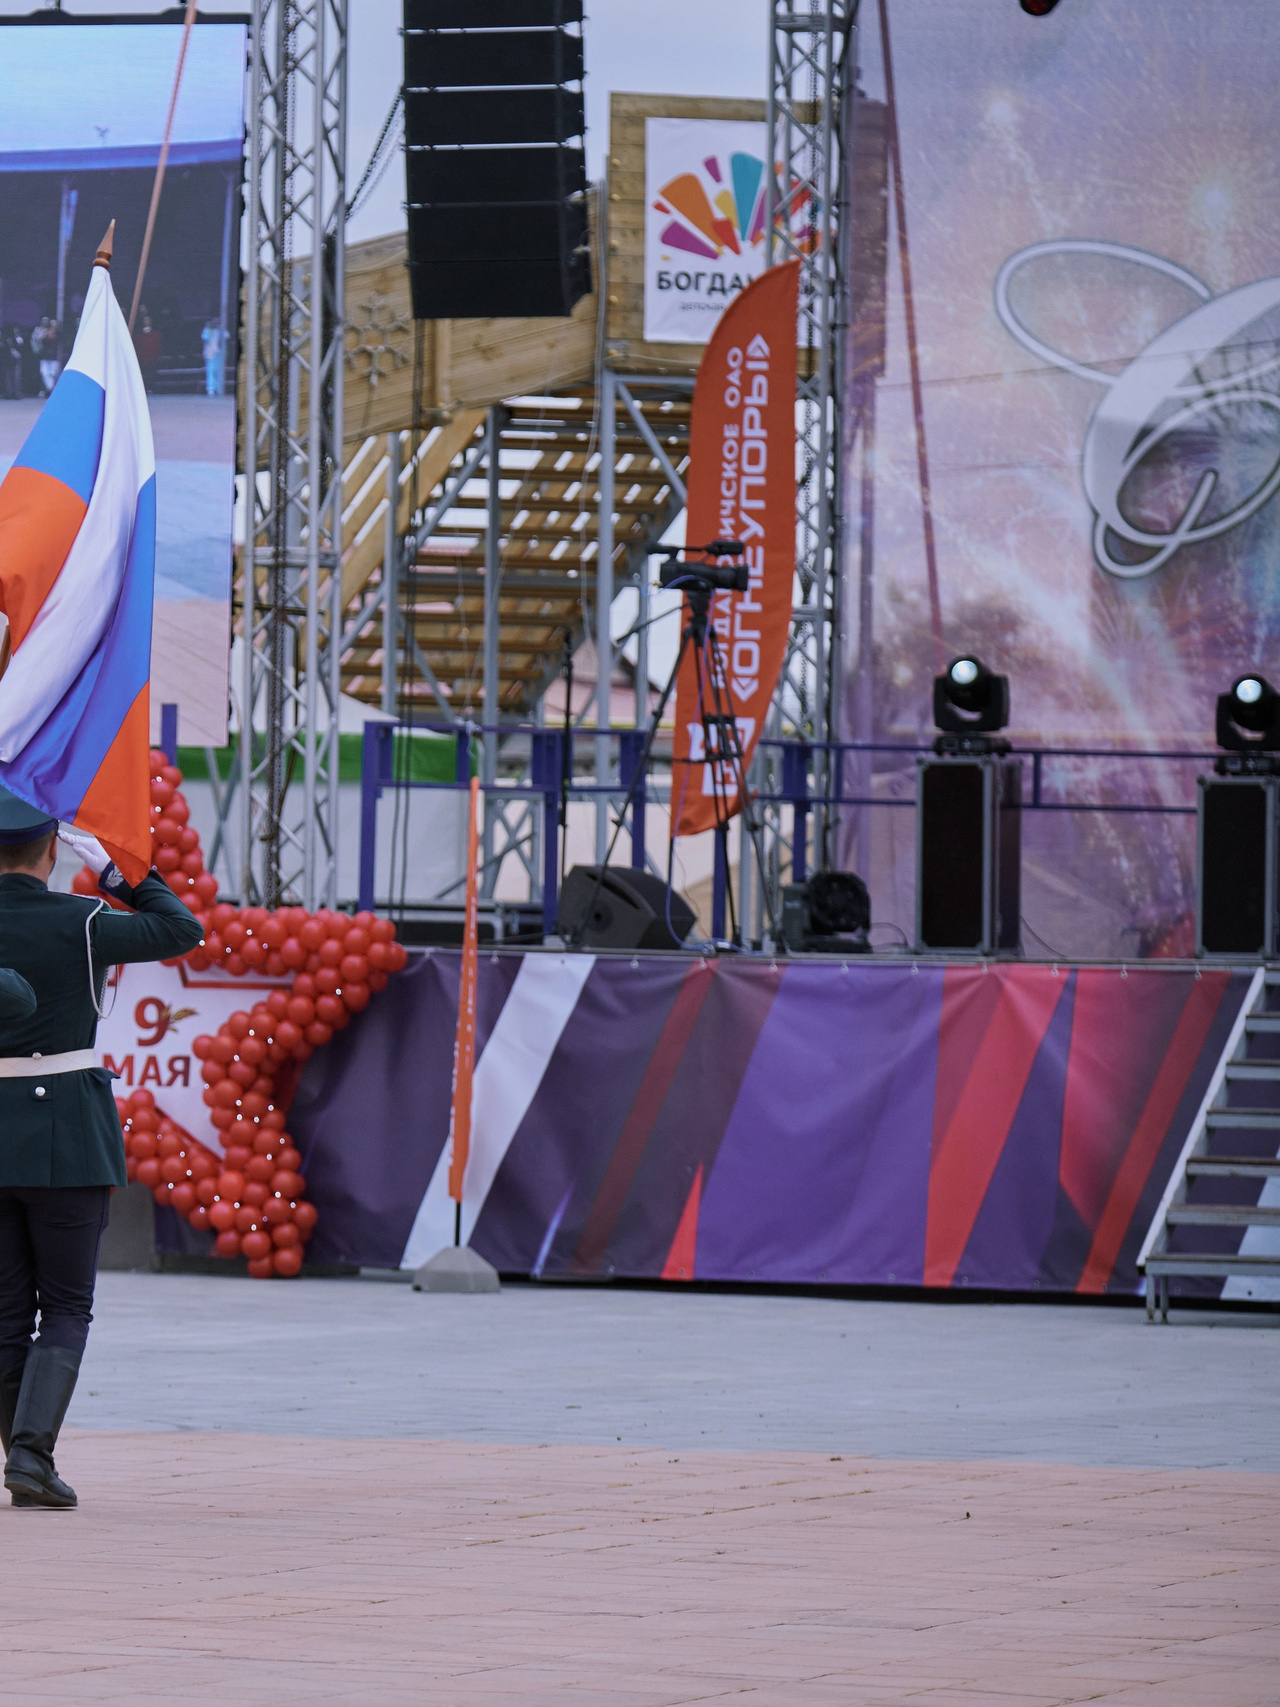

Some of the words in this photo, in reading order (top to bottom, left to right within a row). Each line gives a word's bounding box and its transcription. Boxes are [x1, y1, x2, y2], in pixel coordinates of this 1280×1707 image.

[657, 270, 753, 296] БОГДА
[724, 346, 743, 408] ОАО
[134, 996, 172, 1047] 9
[102, 1055, 191, 1088] МАЯ
